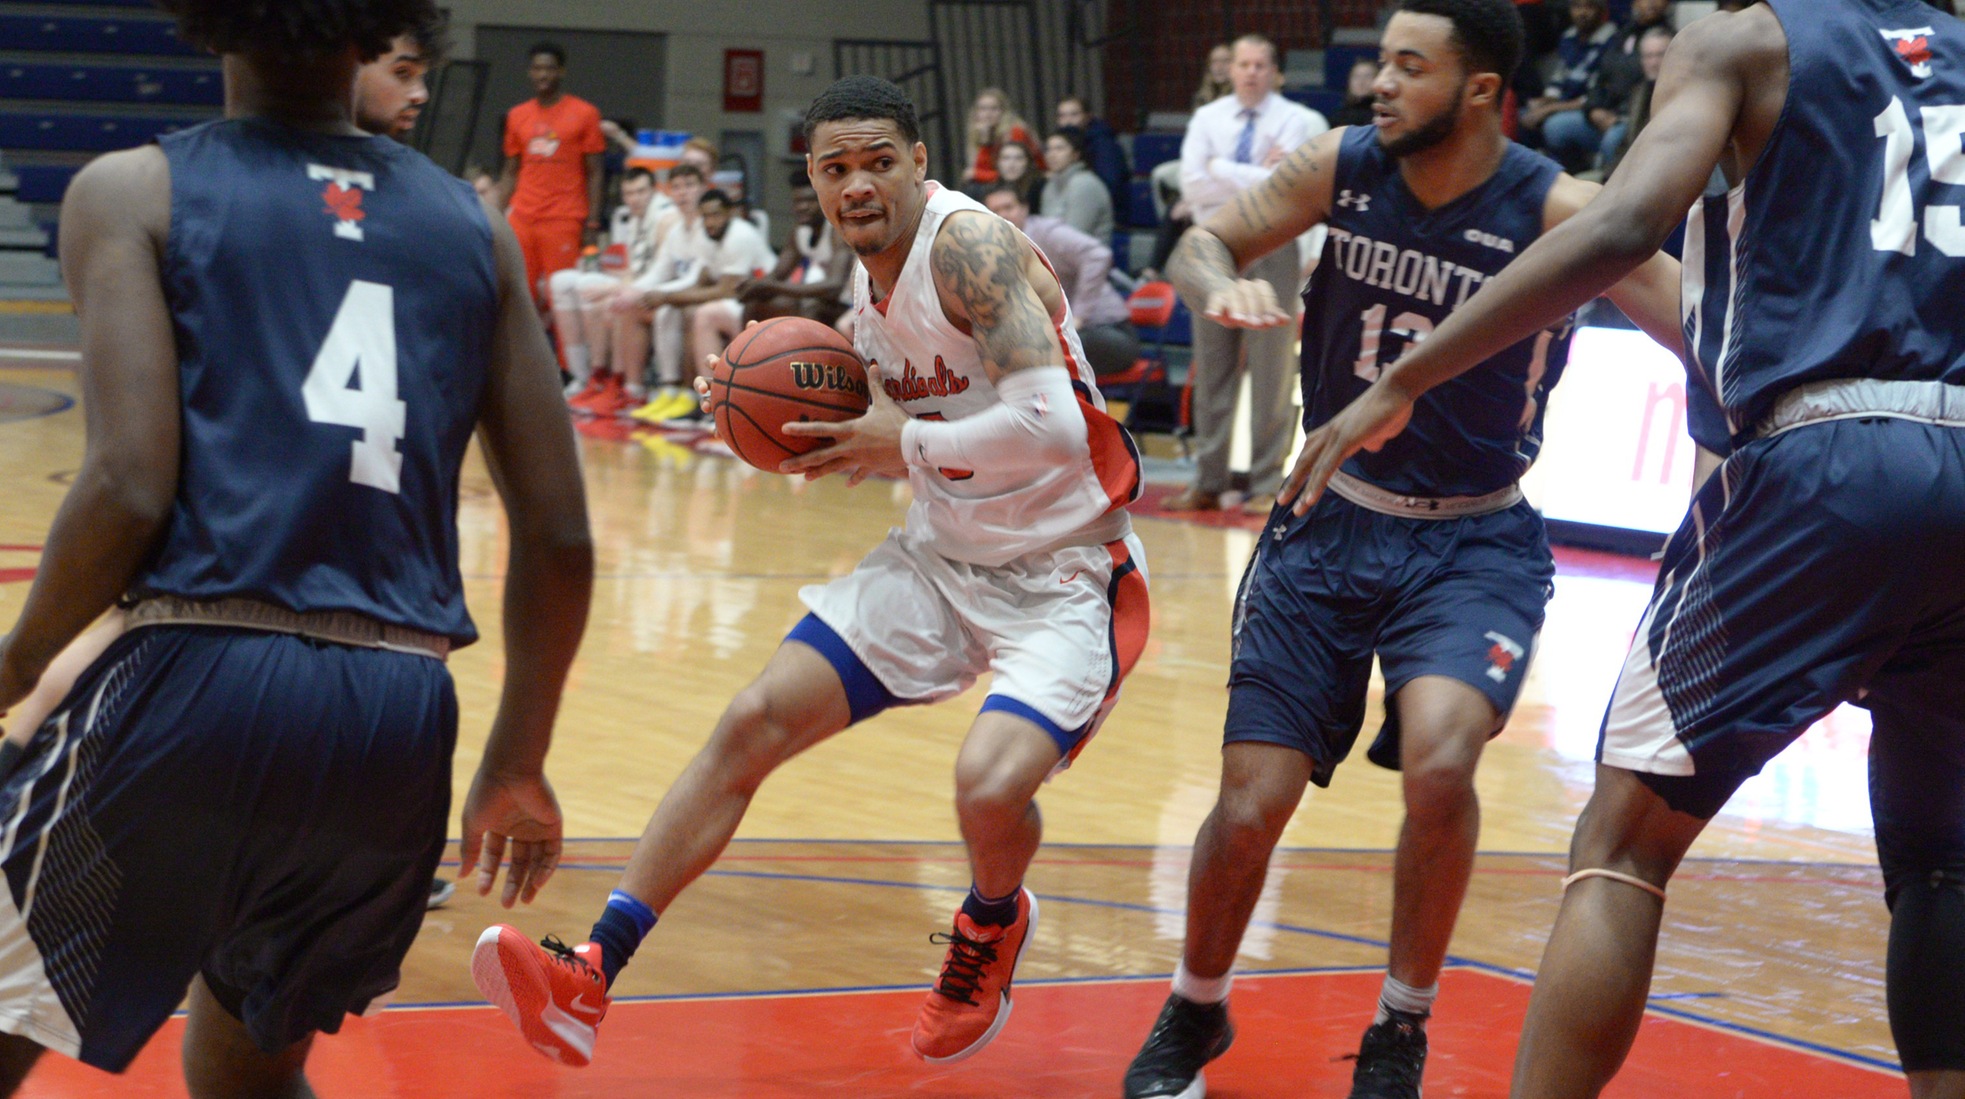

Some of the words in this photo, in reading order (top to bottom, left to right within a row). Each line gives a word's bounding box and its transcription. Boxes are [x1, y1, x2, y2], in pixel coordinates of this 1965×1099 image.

[1870, 94, 1965, 257] 15
[1328, 227, 1495, 312] TORONT
[1463, 229, 1514, 254] OUA
[301, 279, 407, 495] 4
